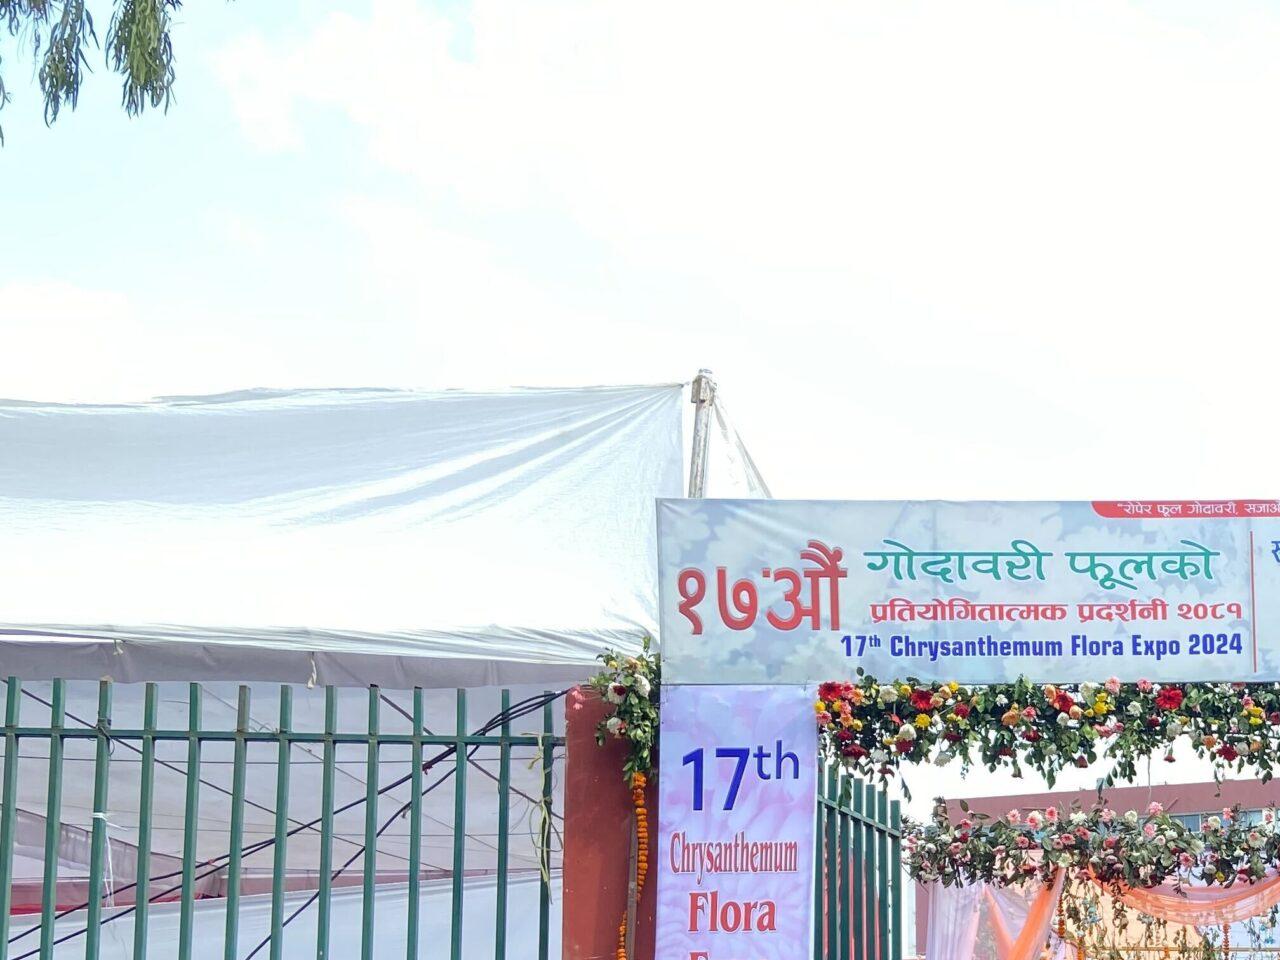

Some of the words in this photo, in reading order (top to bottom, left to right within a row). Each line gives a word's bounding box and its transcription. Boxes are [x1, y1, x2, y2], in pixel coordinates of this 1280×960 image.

[1157, 503, 1182, 517] फूल
[863, 539, 1053, 583] गोदावरी
[1064, 539, 1221, 590] फूलको
[869, 597, 1069, 624] प्रतियोगितात्मक
[1076, 597, 1170, 623] प्रदर्शनी
[1177, 602, 1242, 620] २०८१
[890, 635, 1062, 661] Chrysanthemum
[1071, 634, 1123, 656] Flora
[1132, 634, 1181, 661] Expo
[1188, 633, 1242, 655] 2024
[682, 739, 800, 812] 17th
[669, 831, 798, 885] Chrysanthemum
[687, 891, 777, 933] Flora
